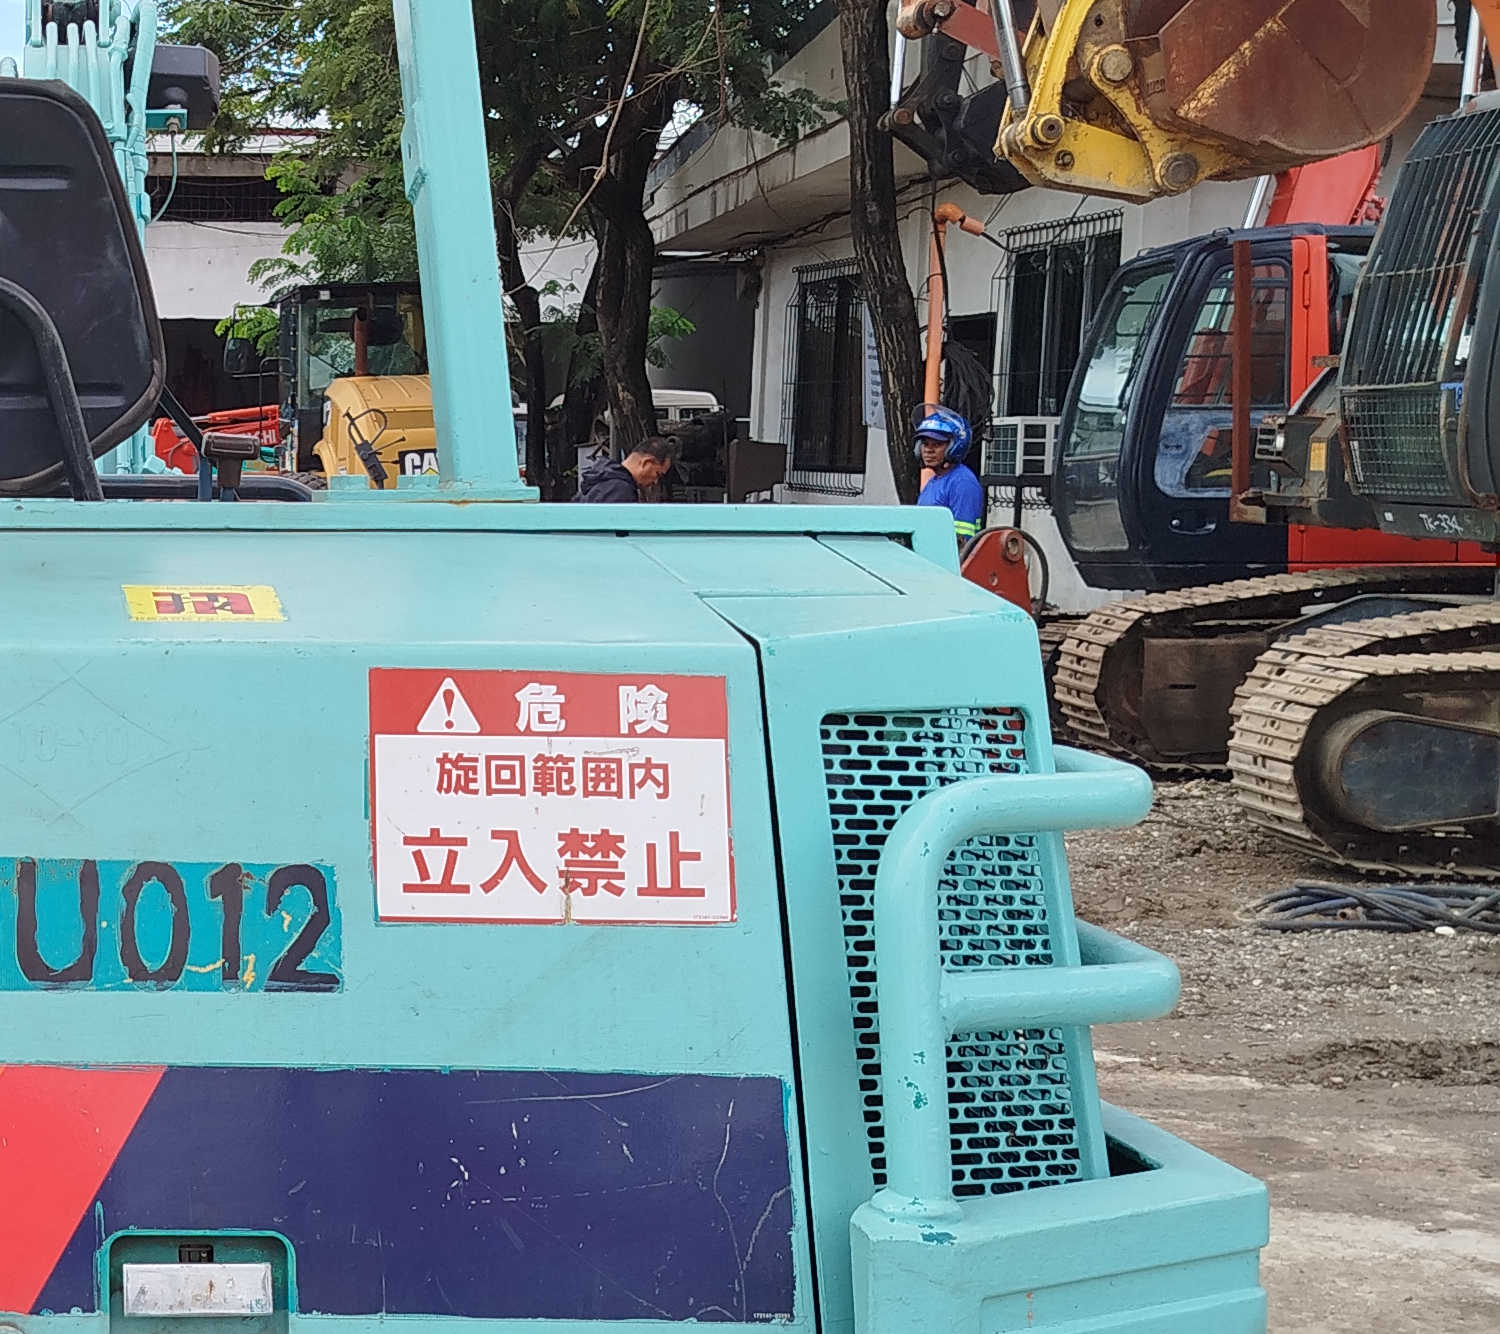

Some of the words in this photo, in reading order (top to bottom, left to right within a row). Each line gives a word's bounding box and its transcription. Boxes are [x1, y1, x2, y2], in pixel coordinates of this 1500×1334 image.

[404, 452, 440, 476] CA
[514, 680, 669, 737] 危険
[435, 751, 671, 801] 旋回範囲内
[401, 827, 706, 899] 立入禁止
